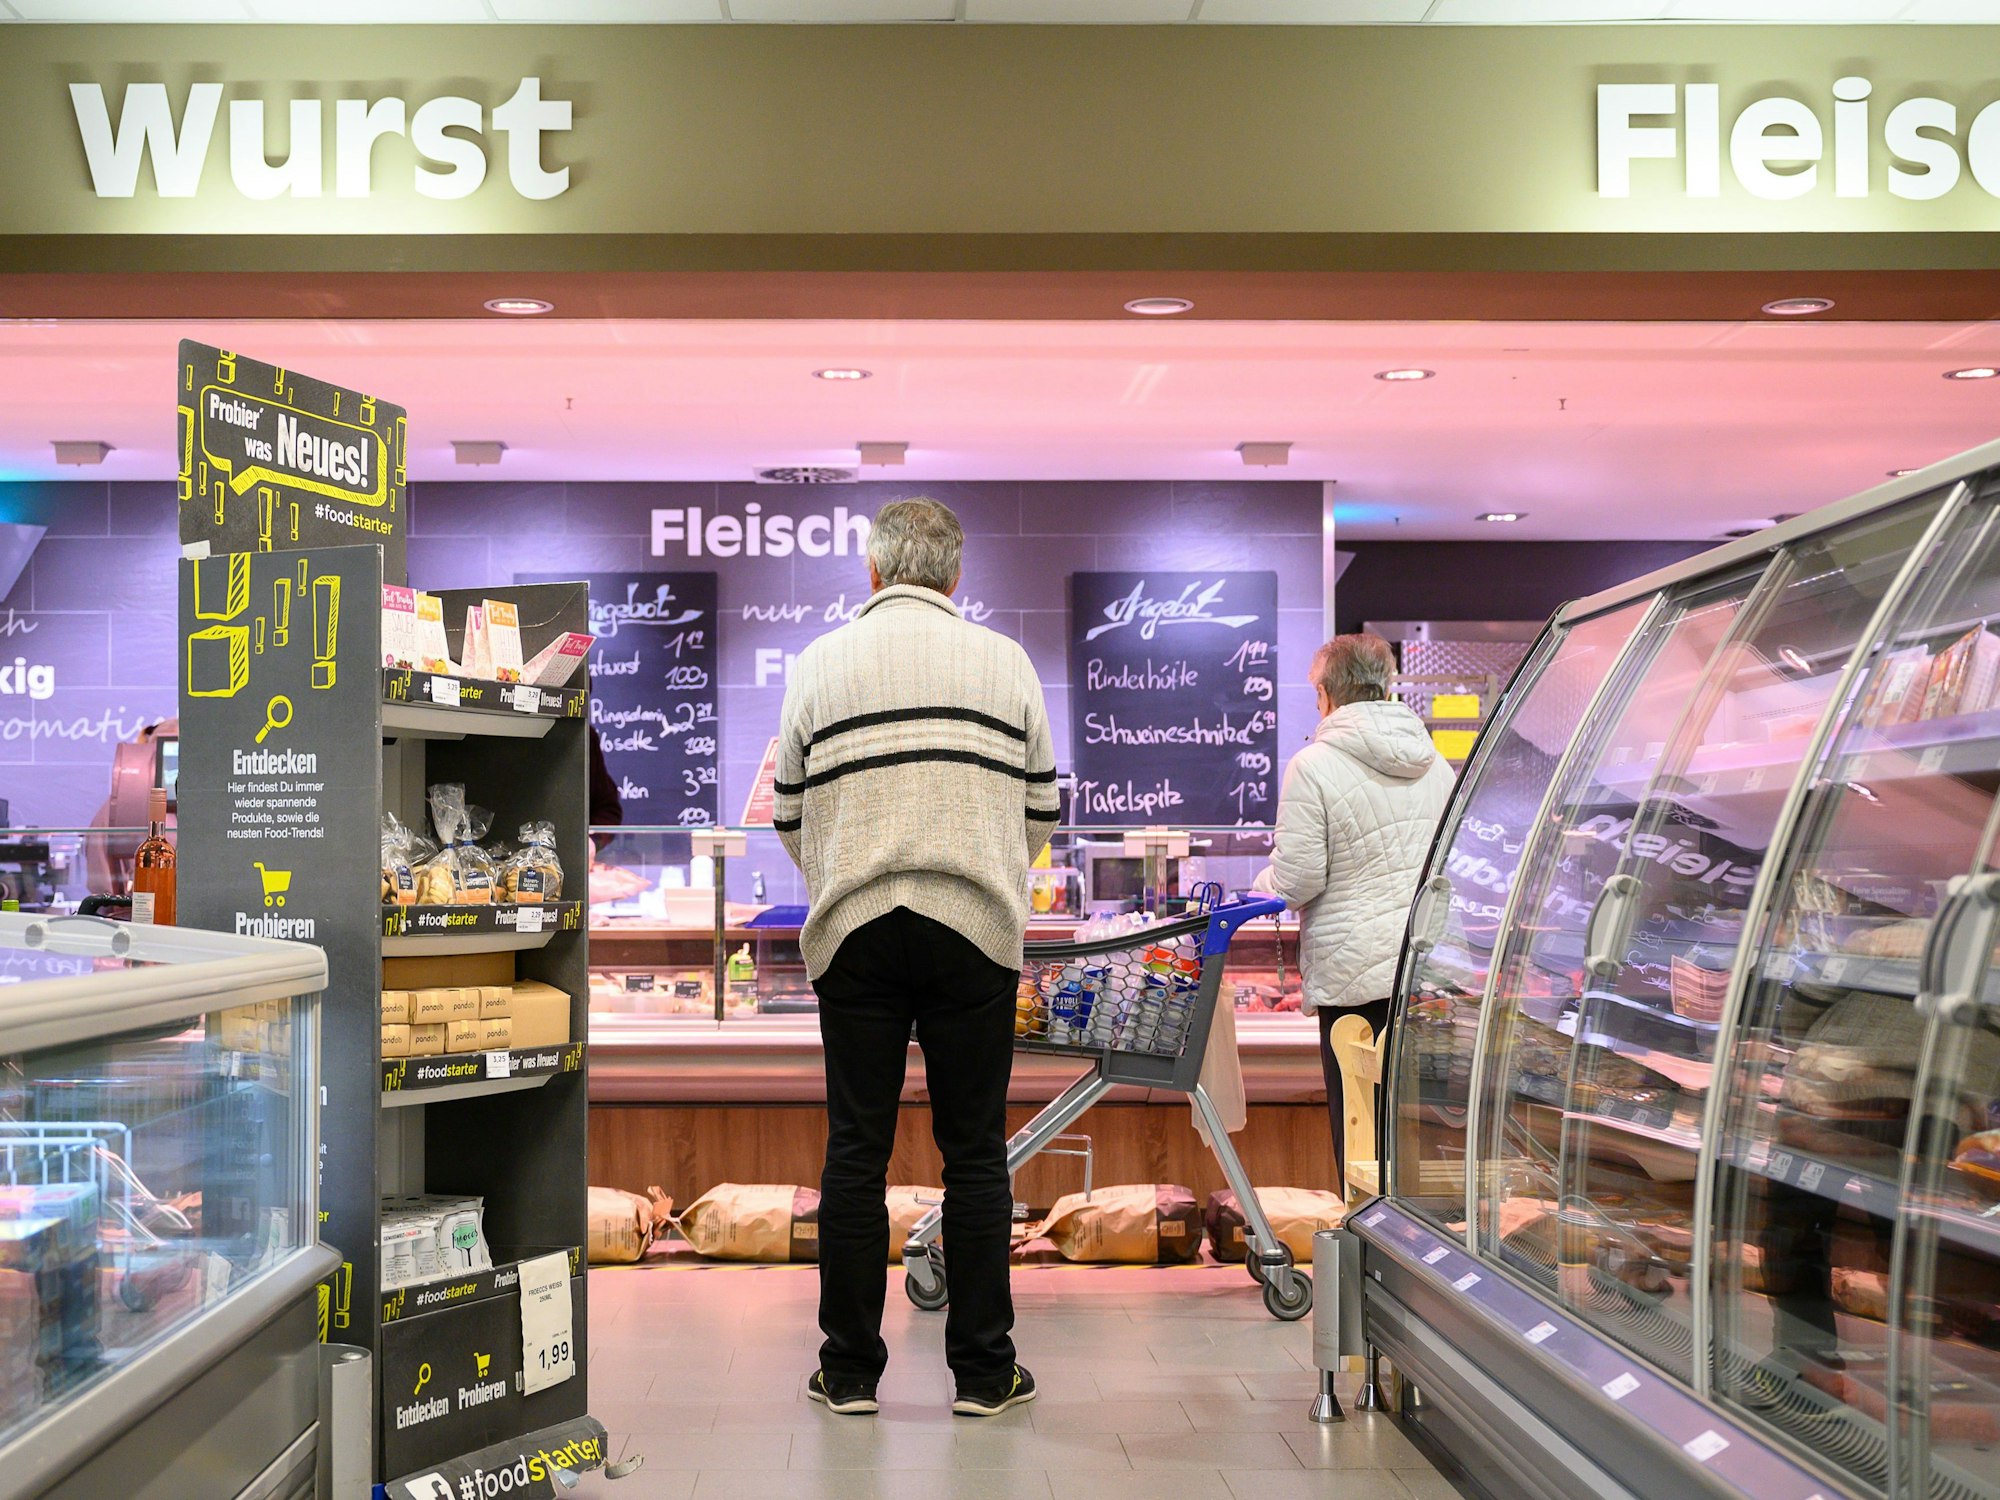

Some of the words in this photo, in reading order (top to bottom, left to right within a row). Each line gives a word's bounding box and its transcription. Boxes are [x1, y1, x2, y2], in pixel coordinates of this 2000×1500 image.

[69, 76, 572, 200] Wurst
[244, 436, 273, 463] was
[277, 413, 369, 488] Neues!
[314, 503, 393, 536] #foodstarter
[651, 502, 872, 558] Fleisch
[589, 582, 677, 638] ngebot
[742, 602, 813, 624] nur
[1103, 577, 1226, 641] Angebot
[233, 748, 317, 775] Entdecken
[227, 782, 246, 793] Hier
[247, 782, 278, 793] findest
[280, 782, 293, 792] Du
[295, 781, 324, 792] immer
[1079, 778, 1185, 816] Tafelspitz
[234, 797, 265, 808] wieder
[266, 797, 317, 810] spannende
[227, 828, 263, 839] neusten
[264, 827, 324, 839] Food-Trends!
[231, 812, 275, 825] Produkte,
[276, 813, 303, 823] sowie
[305, 812, 319, 823] die
[235, 911, 315, 939] Probieren
[417, 1063, 478, 1080] #foodstarter
[522, 1056, 536, 1070] was
[536, 1052, 560, 1068] Neues!
[416, 1281, 477, 1306] #foodstarter
[548, 1280, 563, 1291] WEISS
[539, 1341, 569, 1370] 1,99
[458, 1378, 506, 1410] Probieren
[396, 1395, 449, 1430] Entdecken
[459, 1437, 601, 1500] #foodstarter
